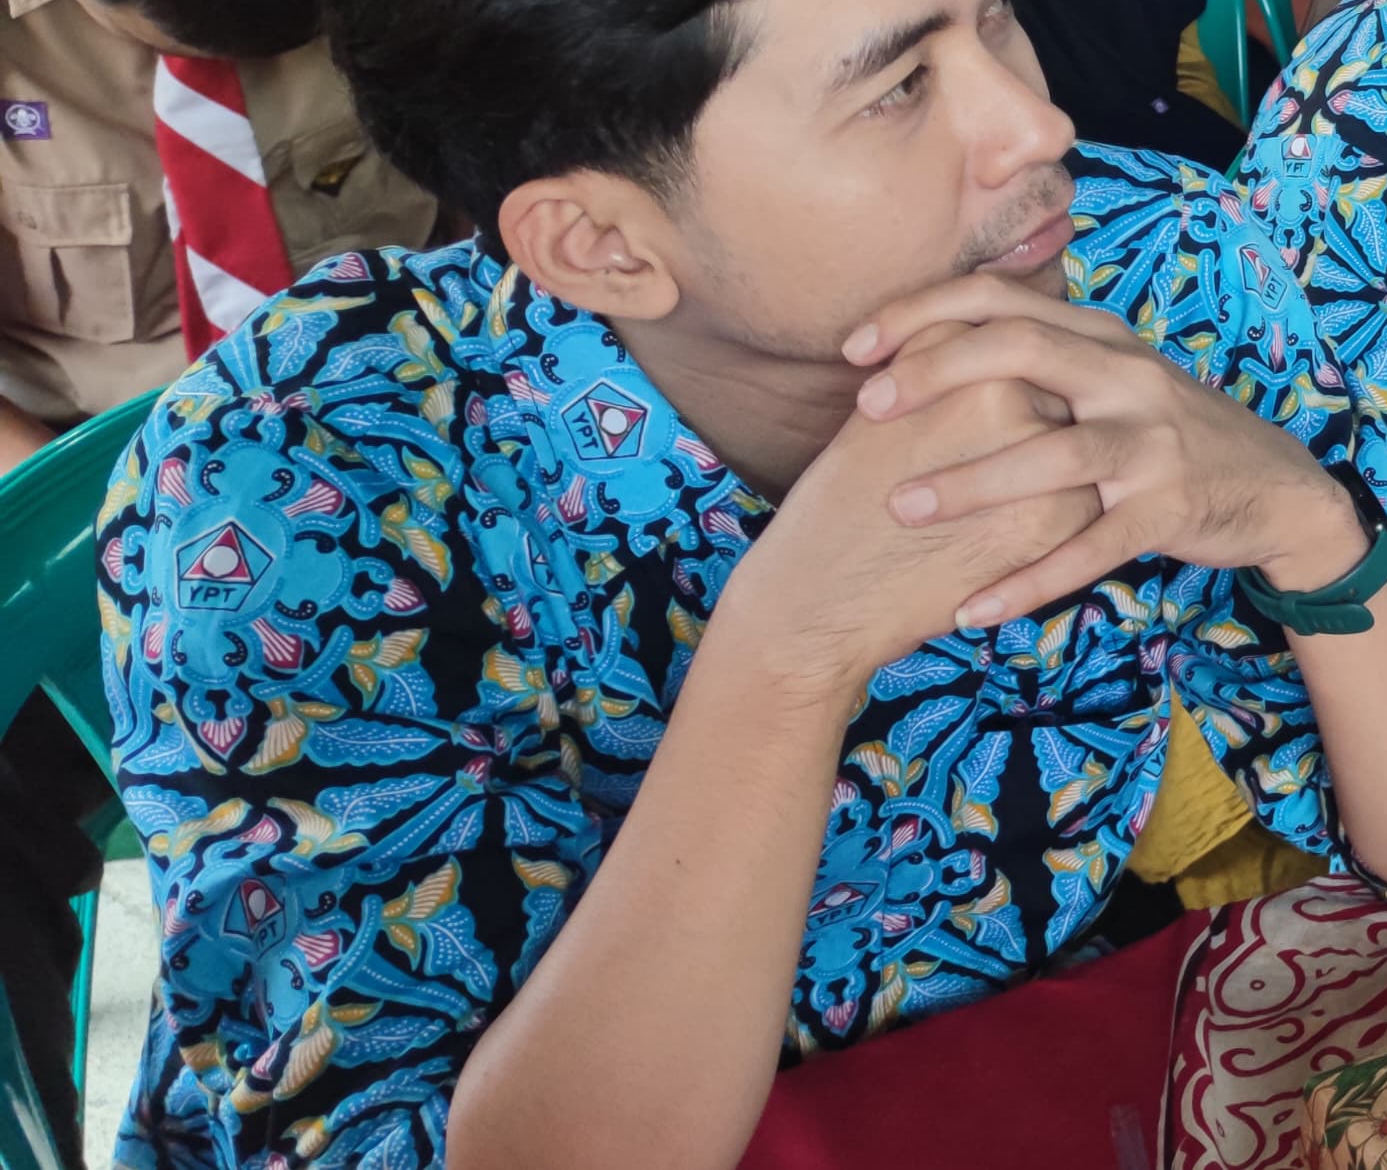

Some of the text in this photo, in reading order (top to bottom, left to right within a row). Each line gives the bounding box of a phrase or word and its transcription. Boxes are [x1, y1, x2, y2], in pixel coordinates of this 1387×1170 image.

[1263, 275, 1280, 300] YPT
[569, 411, 600, 452] YPT
[188, 585, 238, 605] YPT
[817, 902, 859, 927] YPT
